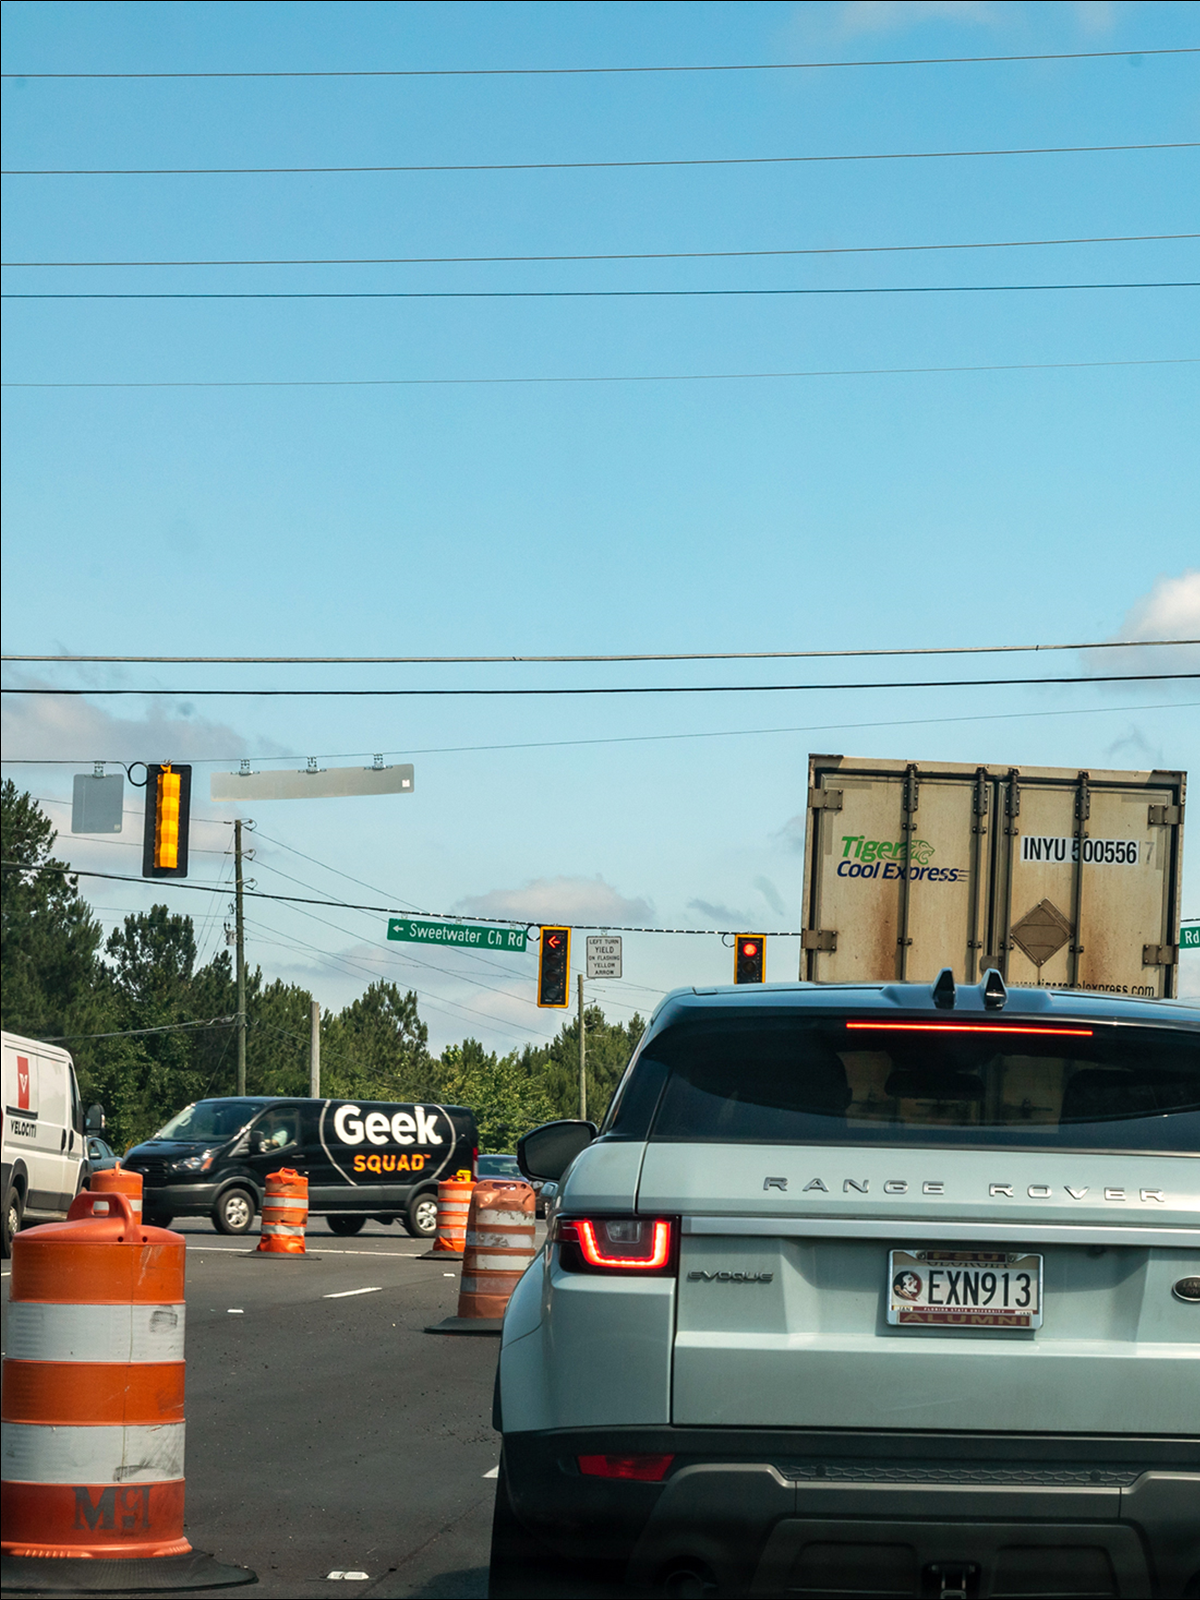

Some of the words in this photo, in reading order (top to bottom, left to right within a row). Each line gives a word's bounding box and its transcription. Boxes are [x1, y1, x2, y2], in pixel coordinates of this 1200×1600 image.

[842, 835, 902, 863] Tiger
[1024, 837, 1066, 861] INYU
[1071, 838, 1137, 864] 500556
[837, 861, 881, 878] Cool
[882, 863, 959, 882] Express
[409, 923, 482, 943] Sweetwater
[487, 930, 502, 945] Ch
[507, 932, 523, 947] Rd
[1185, 930, 1200, 944] Rd
[334, 1105, 443, 1145] Geek
[763, 1177, 945, 1195] RANGE
[989, 1183, 1166, 1202] ROVER
[687, 1270, 774, 1281] EVOQUE
[928, 1270, 1031, 1307] EXN913
[903, 1313, 1027, 1326] ALUMNI
